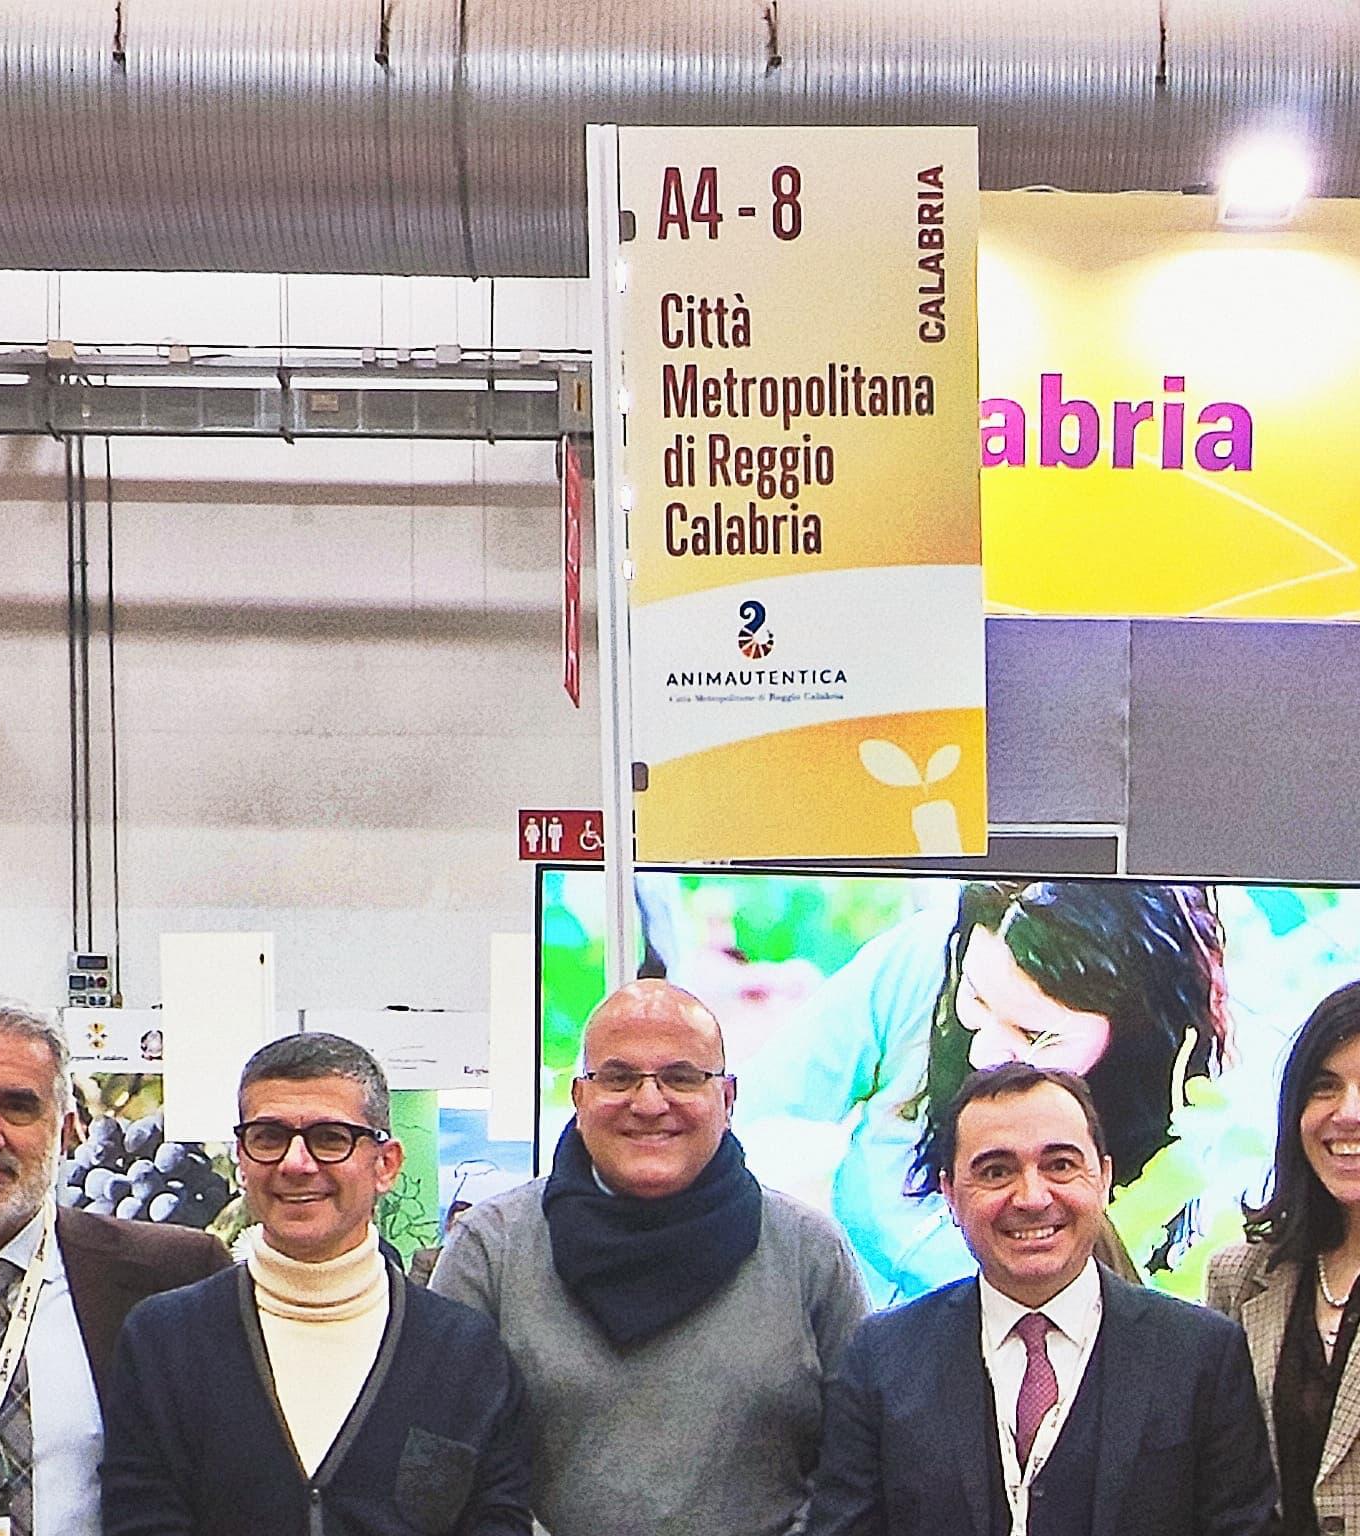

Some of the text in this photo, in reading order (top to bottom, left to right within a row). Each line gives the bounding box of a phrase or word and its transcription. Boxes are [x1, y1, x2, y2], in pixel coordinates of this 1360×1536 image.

[658, 165, 802, 241] A4 - 8
[917, 164, 946, 344] CALABRIA
[660, 292, 751, 349] Città
[662, 363, 935, 430] Metropolitana
[664, 434, 835, 500] di Reggio
[665, 502, 822, 557] Calabria
[666, 669, 848, 687] ANIMAUTENTICA
